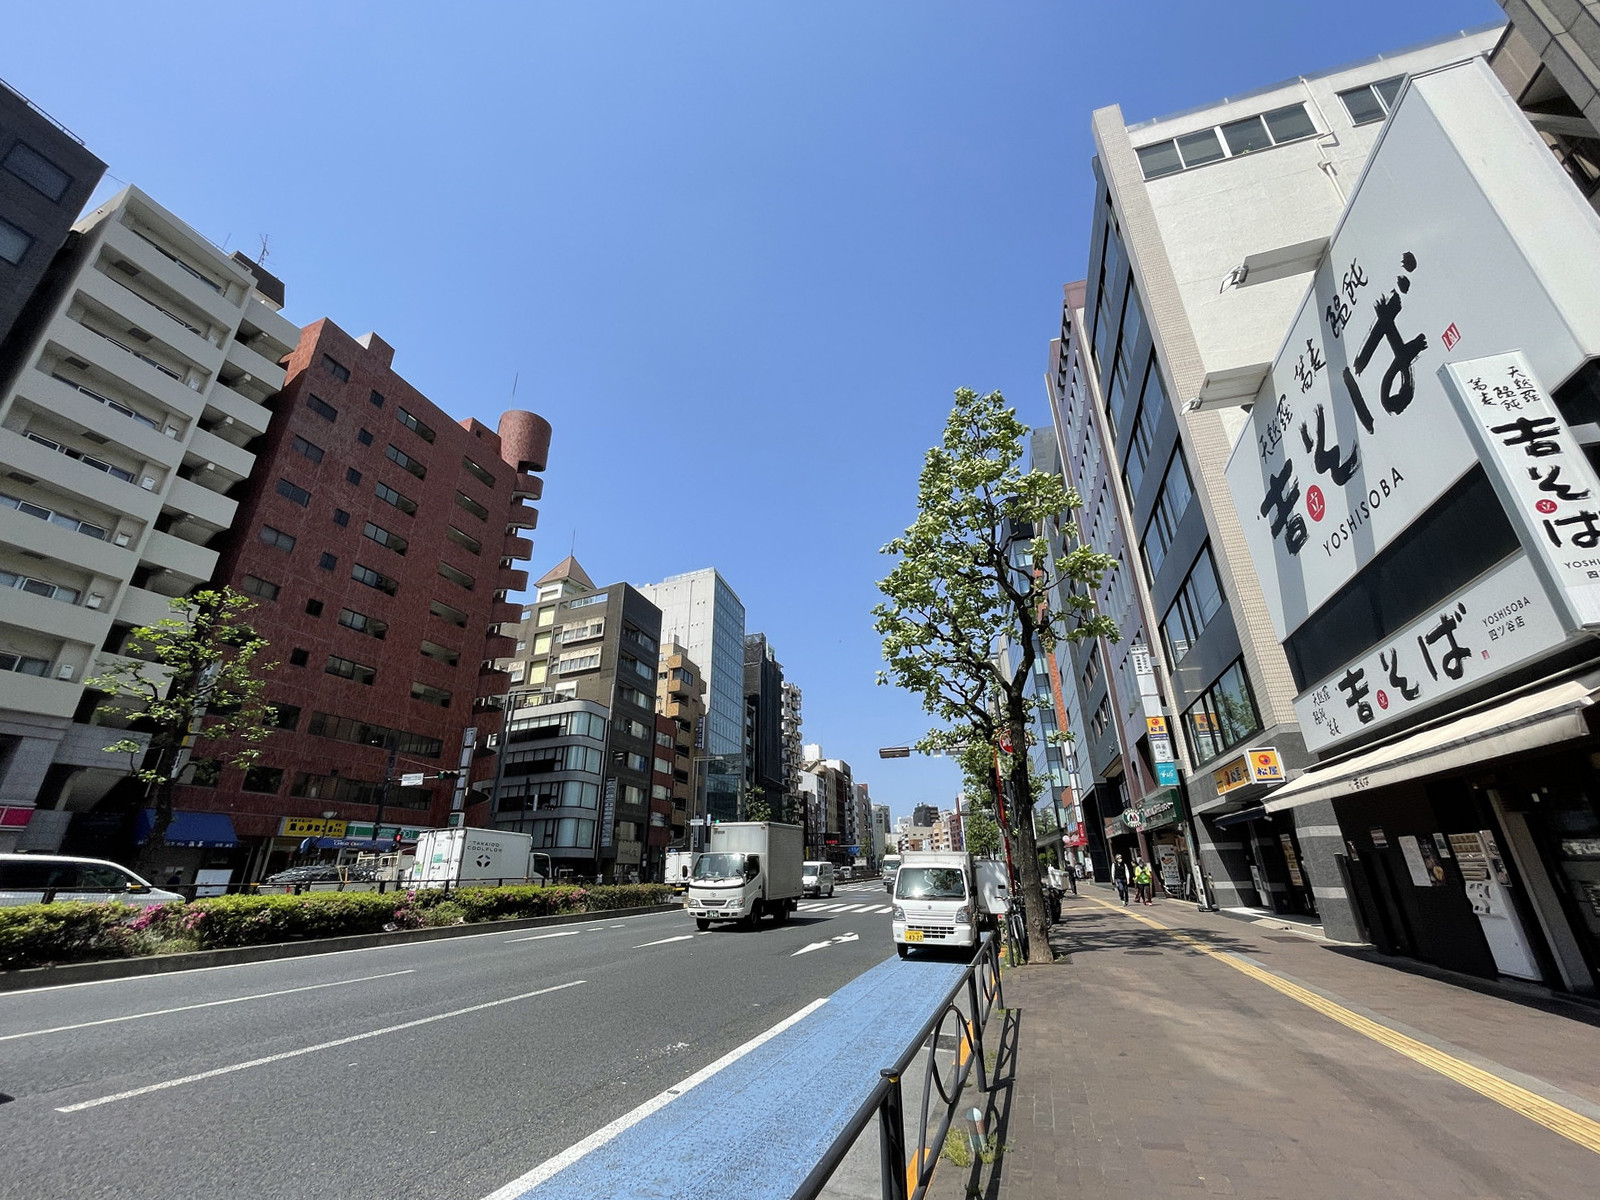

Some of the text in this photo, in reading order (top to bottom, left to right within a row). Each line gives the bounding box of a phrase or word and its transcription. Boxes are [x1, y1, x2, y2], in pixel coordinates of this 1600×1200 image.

[1256, 250, 1430, 557] 吉そば
[1323, 466, 1405, 557] YOSHISOBA
[1586, 570, 1600, 579] 四
[1482, 596, 1531, 628] YOSHISOBA
[1488, 615, 1526, 641] 四ツ谷店
[1336, 601, 1472, 724] 吉そば
[1257, 766, 1279, 776] 松屋
